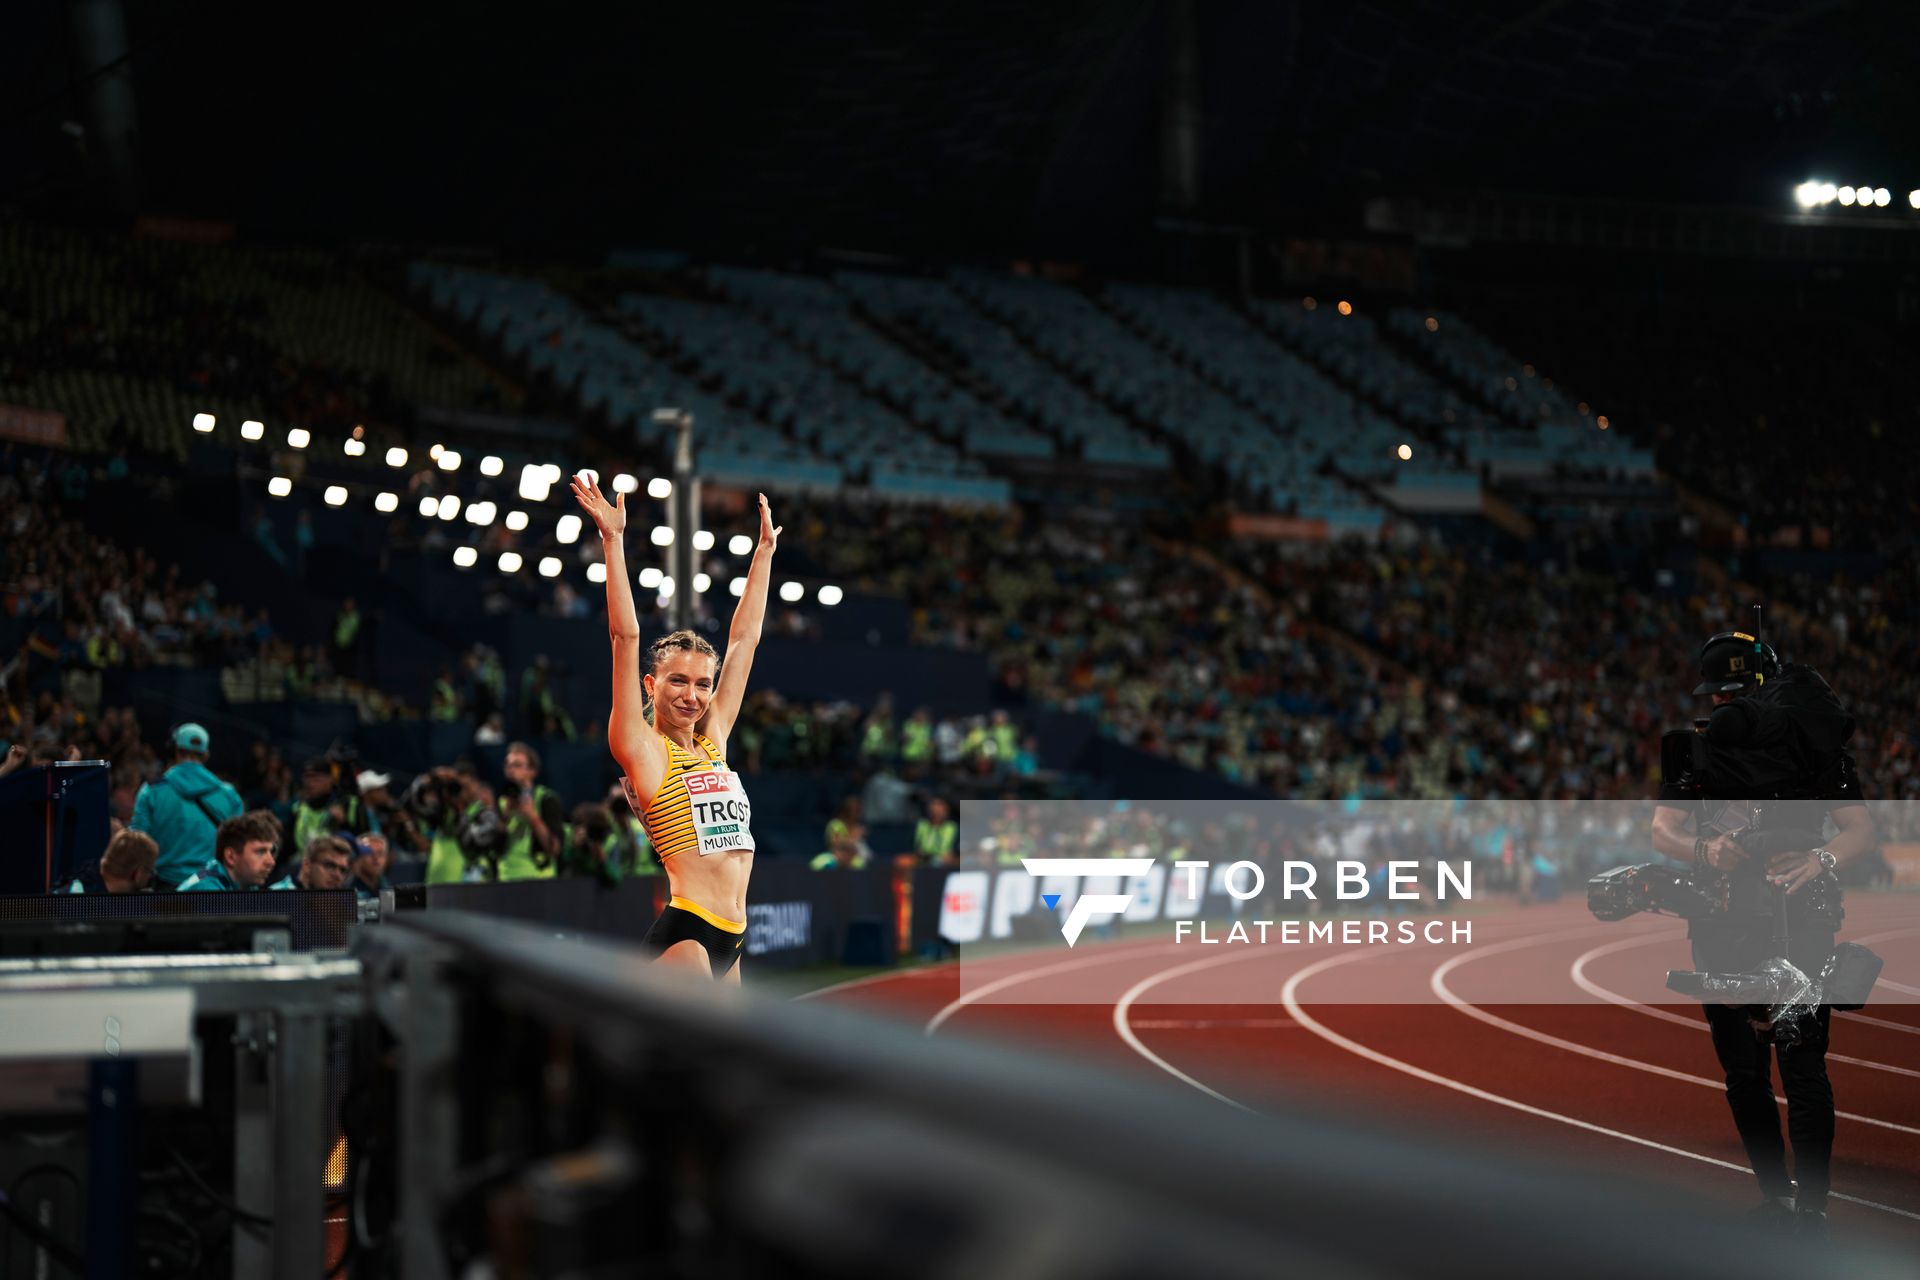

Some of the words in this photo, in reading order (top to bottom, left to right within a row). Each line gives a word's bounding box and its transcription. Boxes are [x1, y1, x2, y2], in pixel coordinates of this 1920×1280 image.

[687, 774, 733, 792] SPA
[693, 799, 749, 824] TROST
[721, 824, 738, 833] RUN
[704, 834, 744, 851] MUNIC
